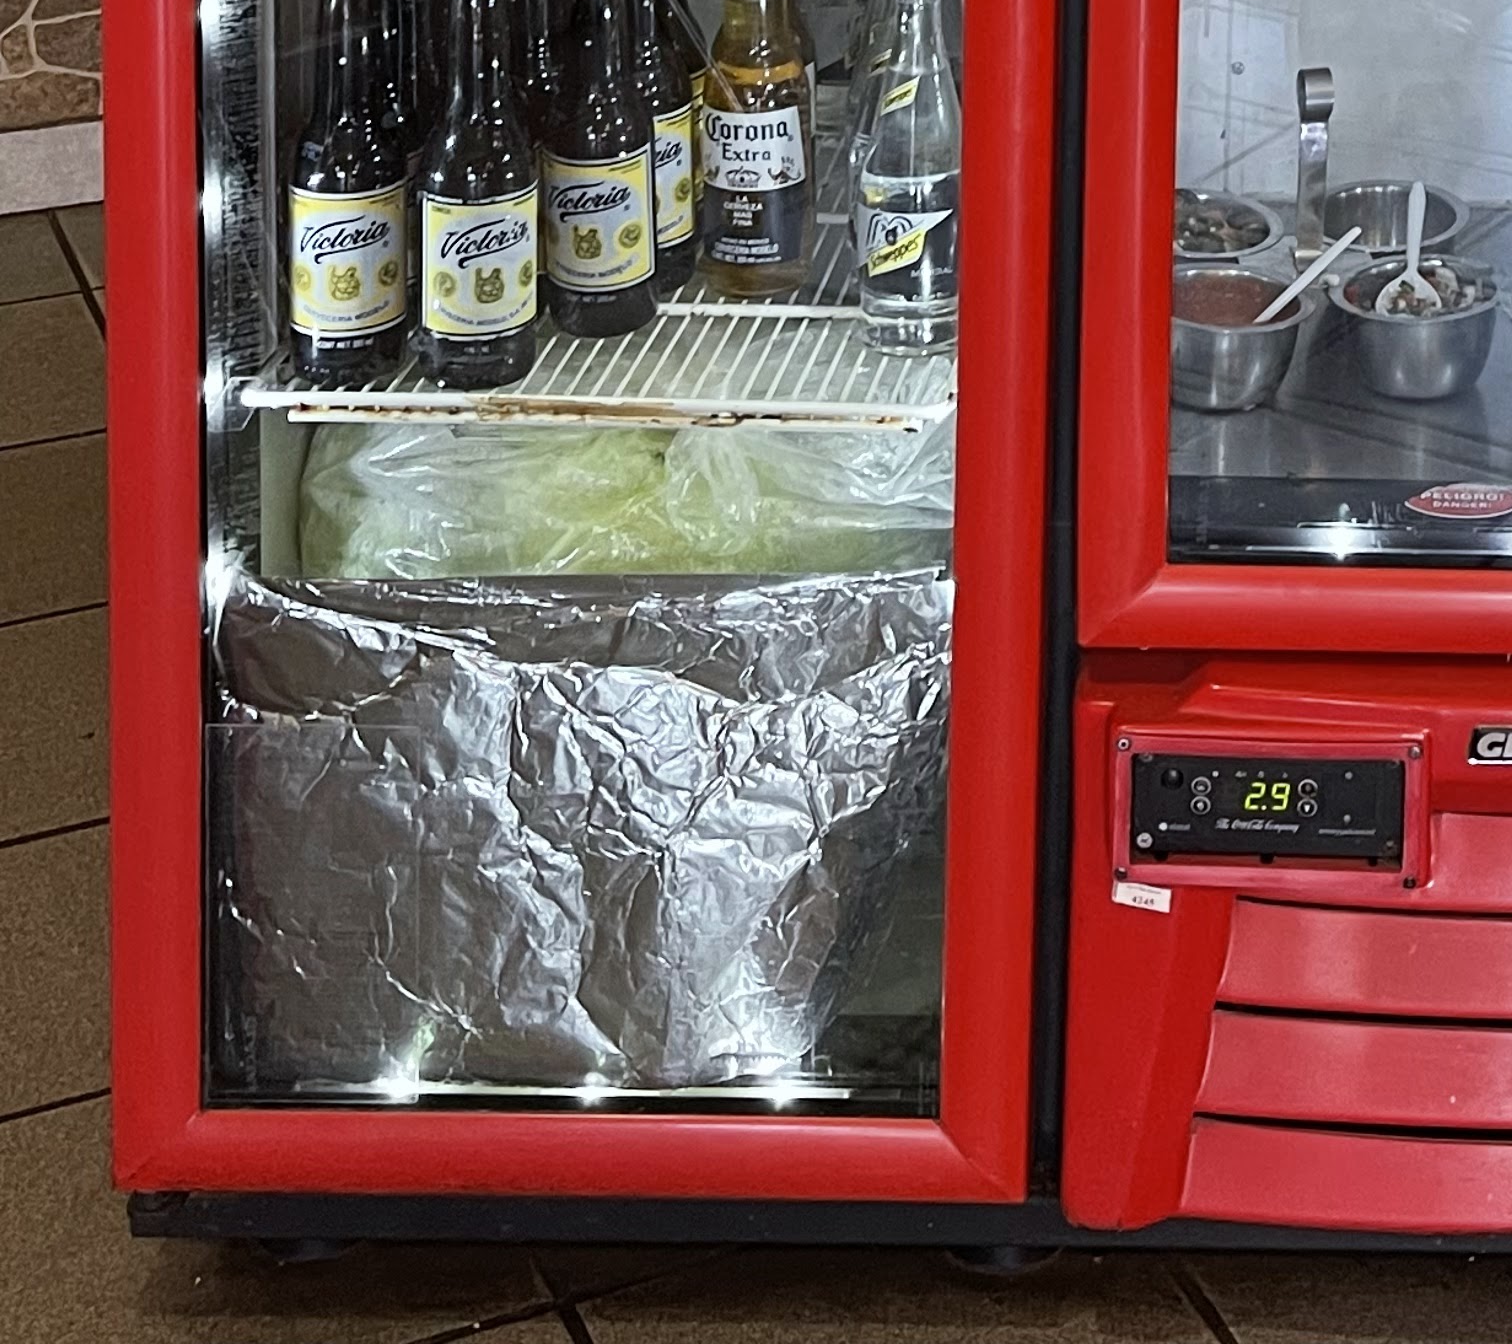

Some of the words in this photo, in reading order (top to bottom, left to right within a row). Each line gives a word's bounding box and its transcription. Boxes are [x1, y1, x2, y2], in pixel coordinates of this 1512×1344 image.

[704, 112, 790, 143] Corona
[721, 143, 772, 163] Extra
[547, 180, 632, 223] Victoria
[299, 215, 392, 265] Victoria
[439, 216, 531, 270] Victoria
[1243, 781, 1292, 811] 2.9
